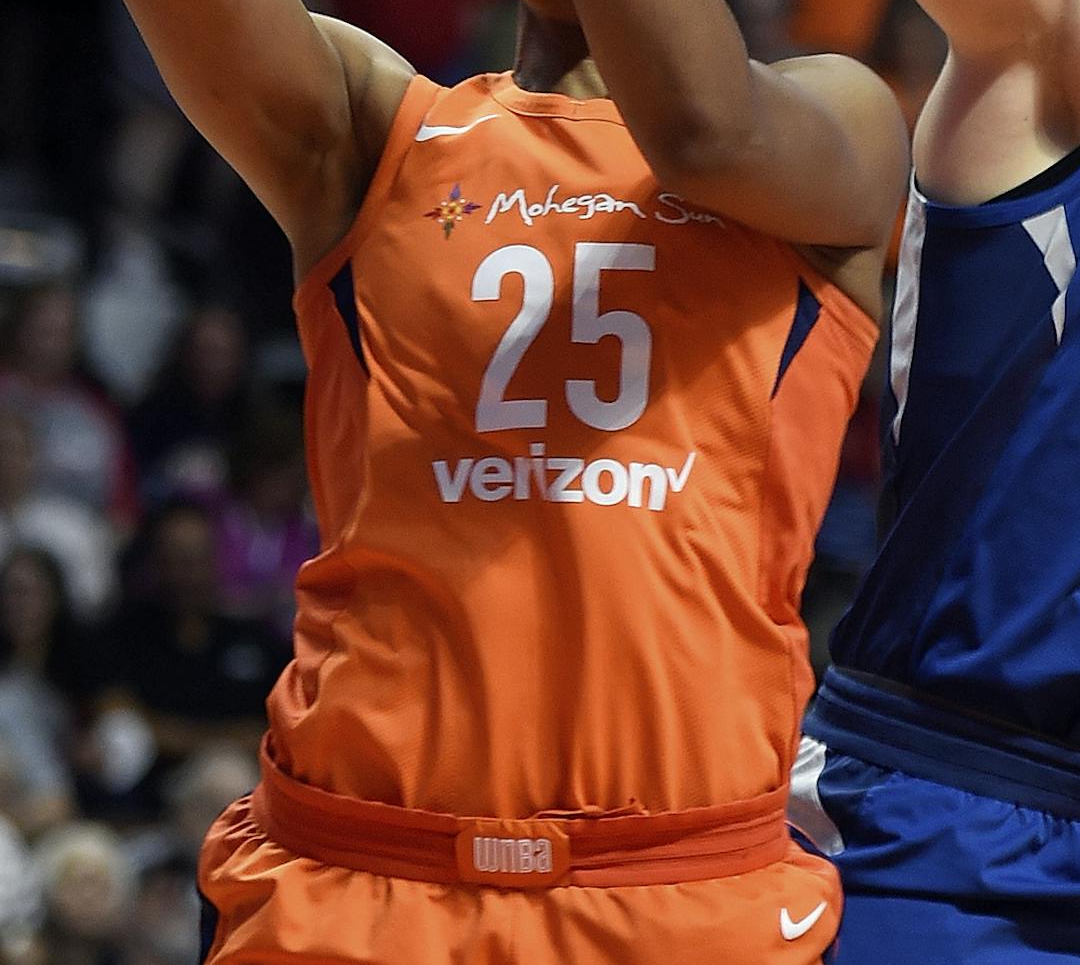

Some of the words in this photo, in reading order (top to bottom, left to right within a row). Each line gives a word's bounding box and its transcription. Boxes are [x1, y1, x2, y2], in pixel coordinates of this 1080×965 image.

[484, 185, 648, 227] Mohegan
[655, 193, 727, 230] Sun
[471, 242, 657, 434] 25
[432, 443, 669, 512] verizon
